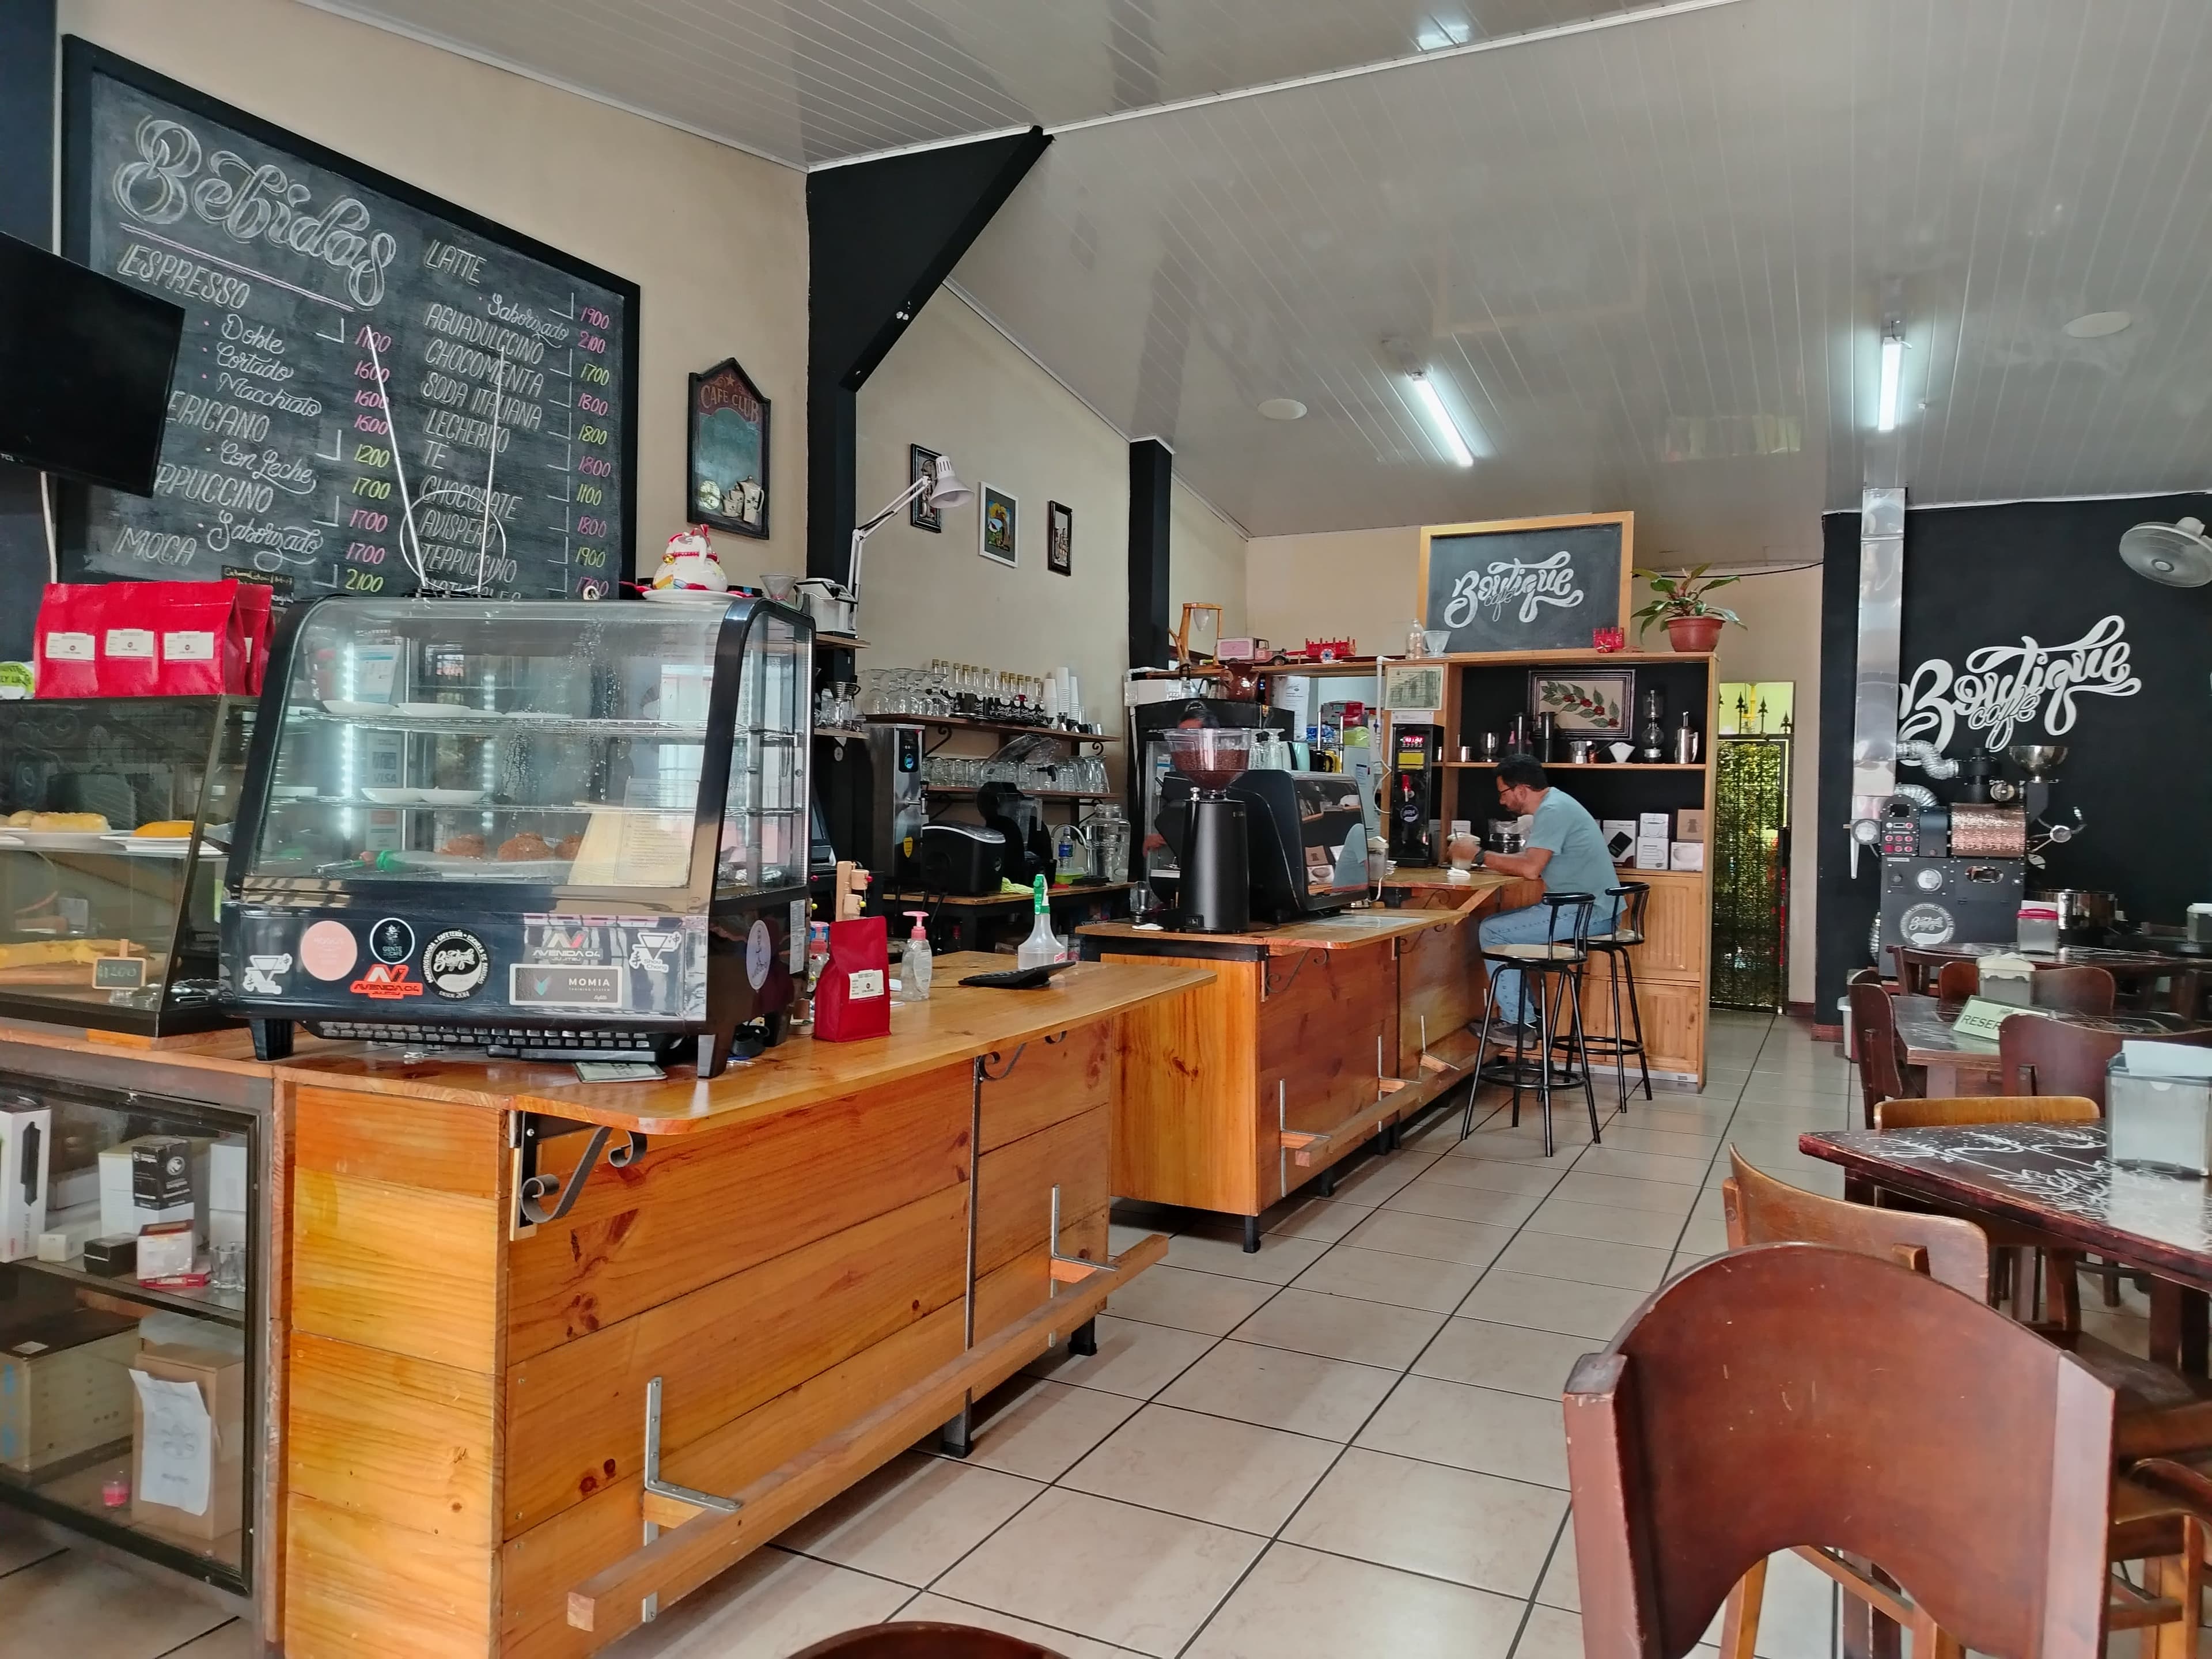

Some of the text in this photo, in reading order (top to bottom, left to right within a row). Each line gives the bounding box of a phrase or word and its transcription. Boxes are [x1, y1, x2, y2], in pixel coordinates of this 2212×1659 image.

[113, 114, 396, 309] Bebidas
[117, 244, 251, 310] ESPRESSO
[424, 239, 487, 284] LATTE
[222, 314, 285, 354] Doble
[425, 303, 543, 364] AGUADULCCINO
[488, 293, 569, 348] Saborizado
[580, 307, 609, 330] 1900
[577, 331, 605, 354] 2100
[217, 342, 294, 381] Cortado
[354, 360, 390, 383] 1600
[425, 338, 543, 397] CHOCOMENTA
[580, 363, 609, 385] 1700
[217, 372, 322, 417] Macchiato
[354, 390, 389, 409] 1600
[421, 372, 542, 430] SODA ITALIANA
[578, 393, 609, 416] 1800
[732, 394, 759, 423] CLUB
[166, 390, 270, 442] ERICANO
[354, 414, 389, 435] 1600
[423, 407, 510, 453] LECHERITO
[577, 424, 607, 445] 1800
[221, 439, 317, 495] Con Leche
[354, 444, 391, 468] 1200
[578, 456, 611, 478] 1800
[154, 463, 274, 513] PPUCCINO
[352, 476, 391, 500] 1700
[419, 475, 522, 521] CHOCOLATE
[576, 483, 601, 506] 1100
[349, 509, 388, 532] 1700
[418, 507, 497, 548] AVISPERO
[577, 516, 607, 538] 1800
[115, 524, 197, 565] MOCA
[207, 509, 323, 572] Saborizado
[346, 541, 385, 565] 1700
[575, 547, 605, 568] 1900
[346, 569, 384, 593] 2100
[1444, 551, 1584, 628] Boutique
[1484, 586, 1516, 622] café
[1898, 615, 2141, 766] Boutique
[1968, 685, 2041, 752] café
[568, 978, 610, 987] MOMIA
[1961, 1015, 2001, 1030] RESER
